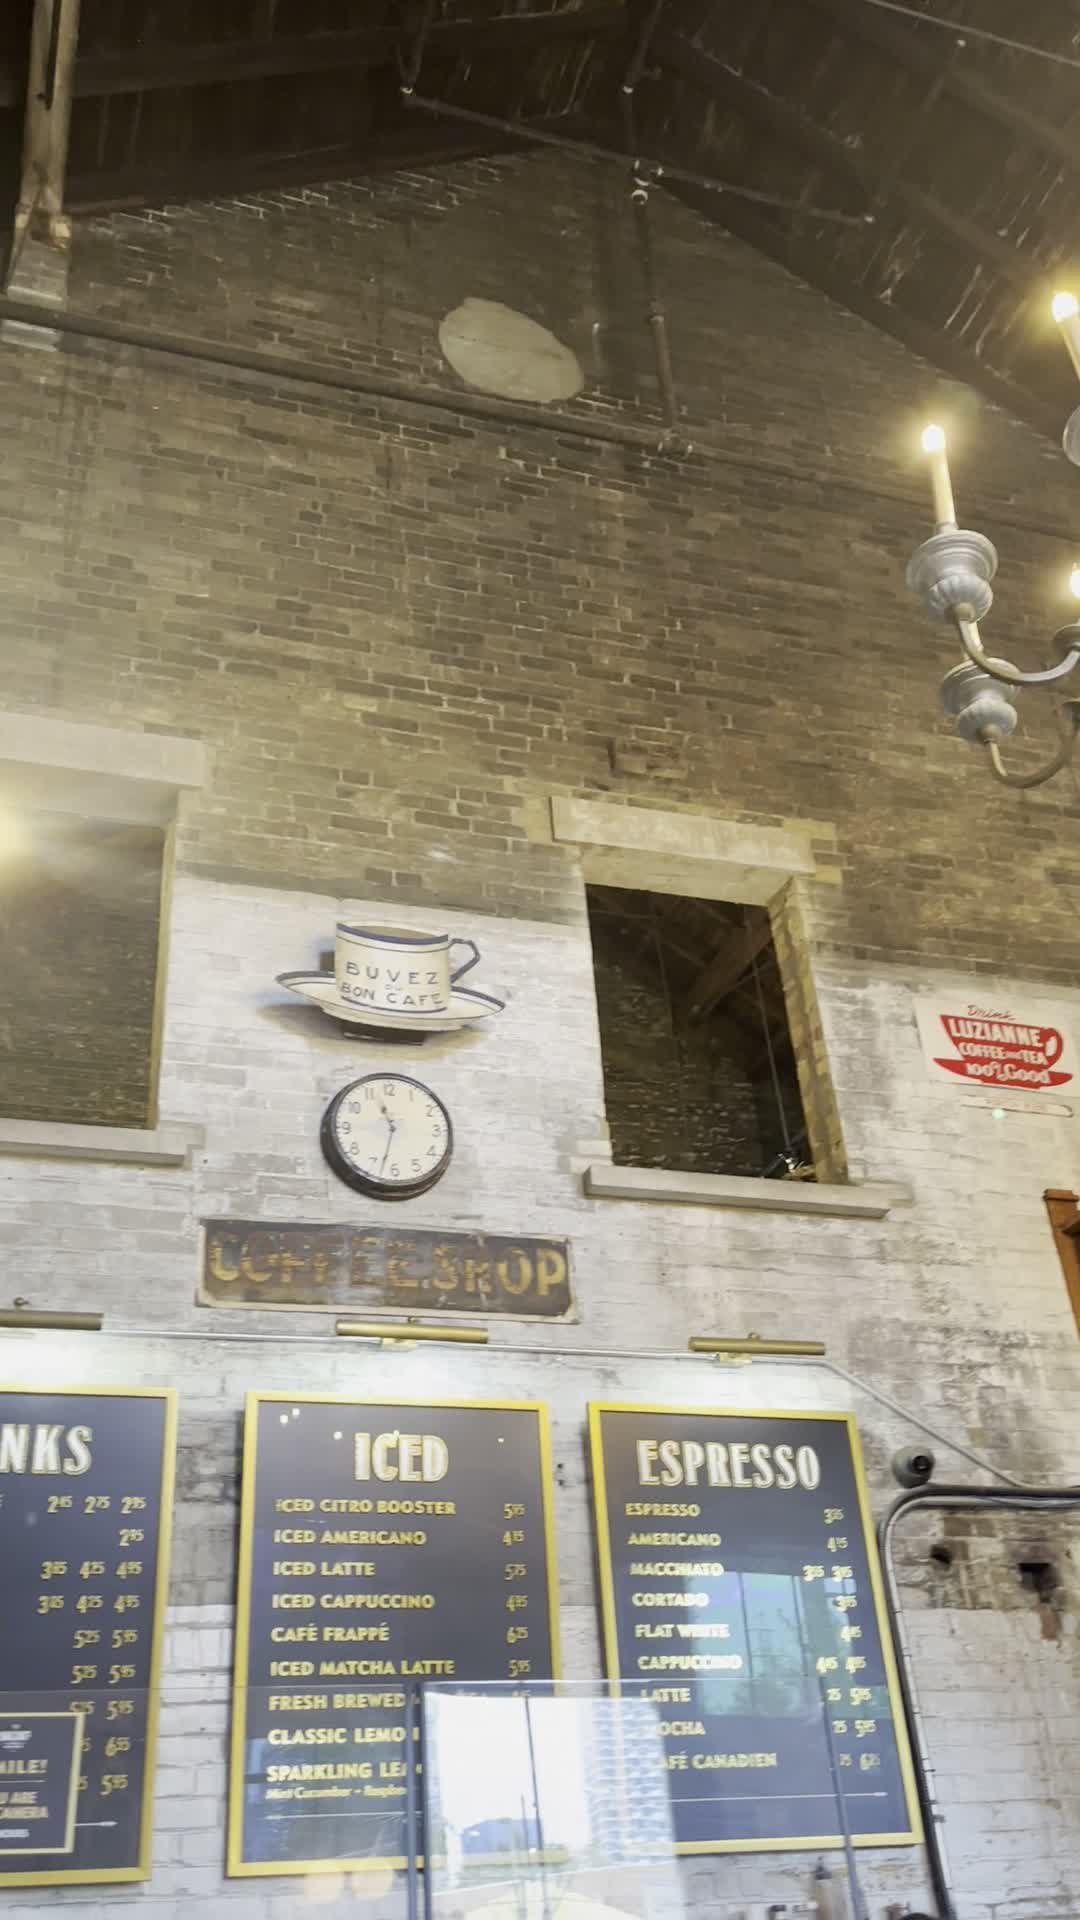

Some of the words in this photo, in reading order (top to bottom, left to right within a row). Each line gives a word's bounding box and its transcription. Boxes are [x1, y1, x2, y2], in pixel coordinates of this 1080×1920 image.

[346, 961, 439, 985] BUVEZ
[340, 982, 375, 1000] BON
[386, 992, 443, 1006] CAFE
[968, 1005, 1016, 1021] Drink
[948, 1018, 1043, 1048] LUZIANNE
[958, 1042, 1006, 1060] COFFEE
[384, 1083, 395, 1097] 12
[350, 1101, 361, 1114] 10
[426, 1104, 433, 1117] 2
[342, 1121, 350, 1135] 9
[432, 1124, 441, 1137] 3
[350, 1142, 359, 1155] 8
[426, 1145, 437, 1157] 4
[368, 1156, 378, 1166] 7
[411, 1158, 421, 1172] 5
[390, 1163, 400, 1177] 6
[354, 1432, 449, 1482] ICED
[636, 1439, 820, 1490] ESPRESSO
[275, 1499, 315, 1512] ICED
[319, 1500, 373, 1513] CITRO
[377, 1500, 456, 1515] BOOSTER
[625, 1503, 700, 1517] ESPRESSO
[273, 1529, 316, 1544] ICED
[320, 1530, 427, 1545] AMERICANO
[628, 1532, 721, 1546] AMERICANO
[272, 1562, 316, 1576] ICED
[320, 1562, 376, 1577] LATTE
[271, 1594, 315, 1608] ICED
[320, 1594, 435, 1609] CAPPUCCINO
[271, 1623, 318, 1642] CAFÉ
[323, 1623, 390, 1641] FRAPPÉ
[635, 1624, 675, 1638] FLAT
[270, 1662, 314, 1676] ICED
[320, 1661, 395, 1676] MATCHA
[401, 1660, 455, 1675] LATTE
[269, 1695, 328, 1710] FRESH
[334, 1693, 405, 1708] BREWED
[268, 1728, 347, 1744] CLASSIC
[656, 1721, 706, 1736] OCHA
[267, 1762, 372, 1782] SPARKLING
